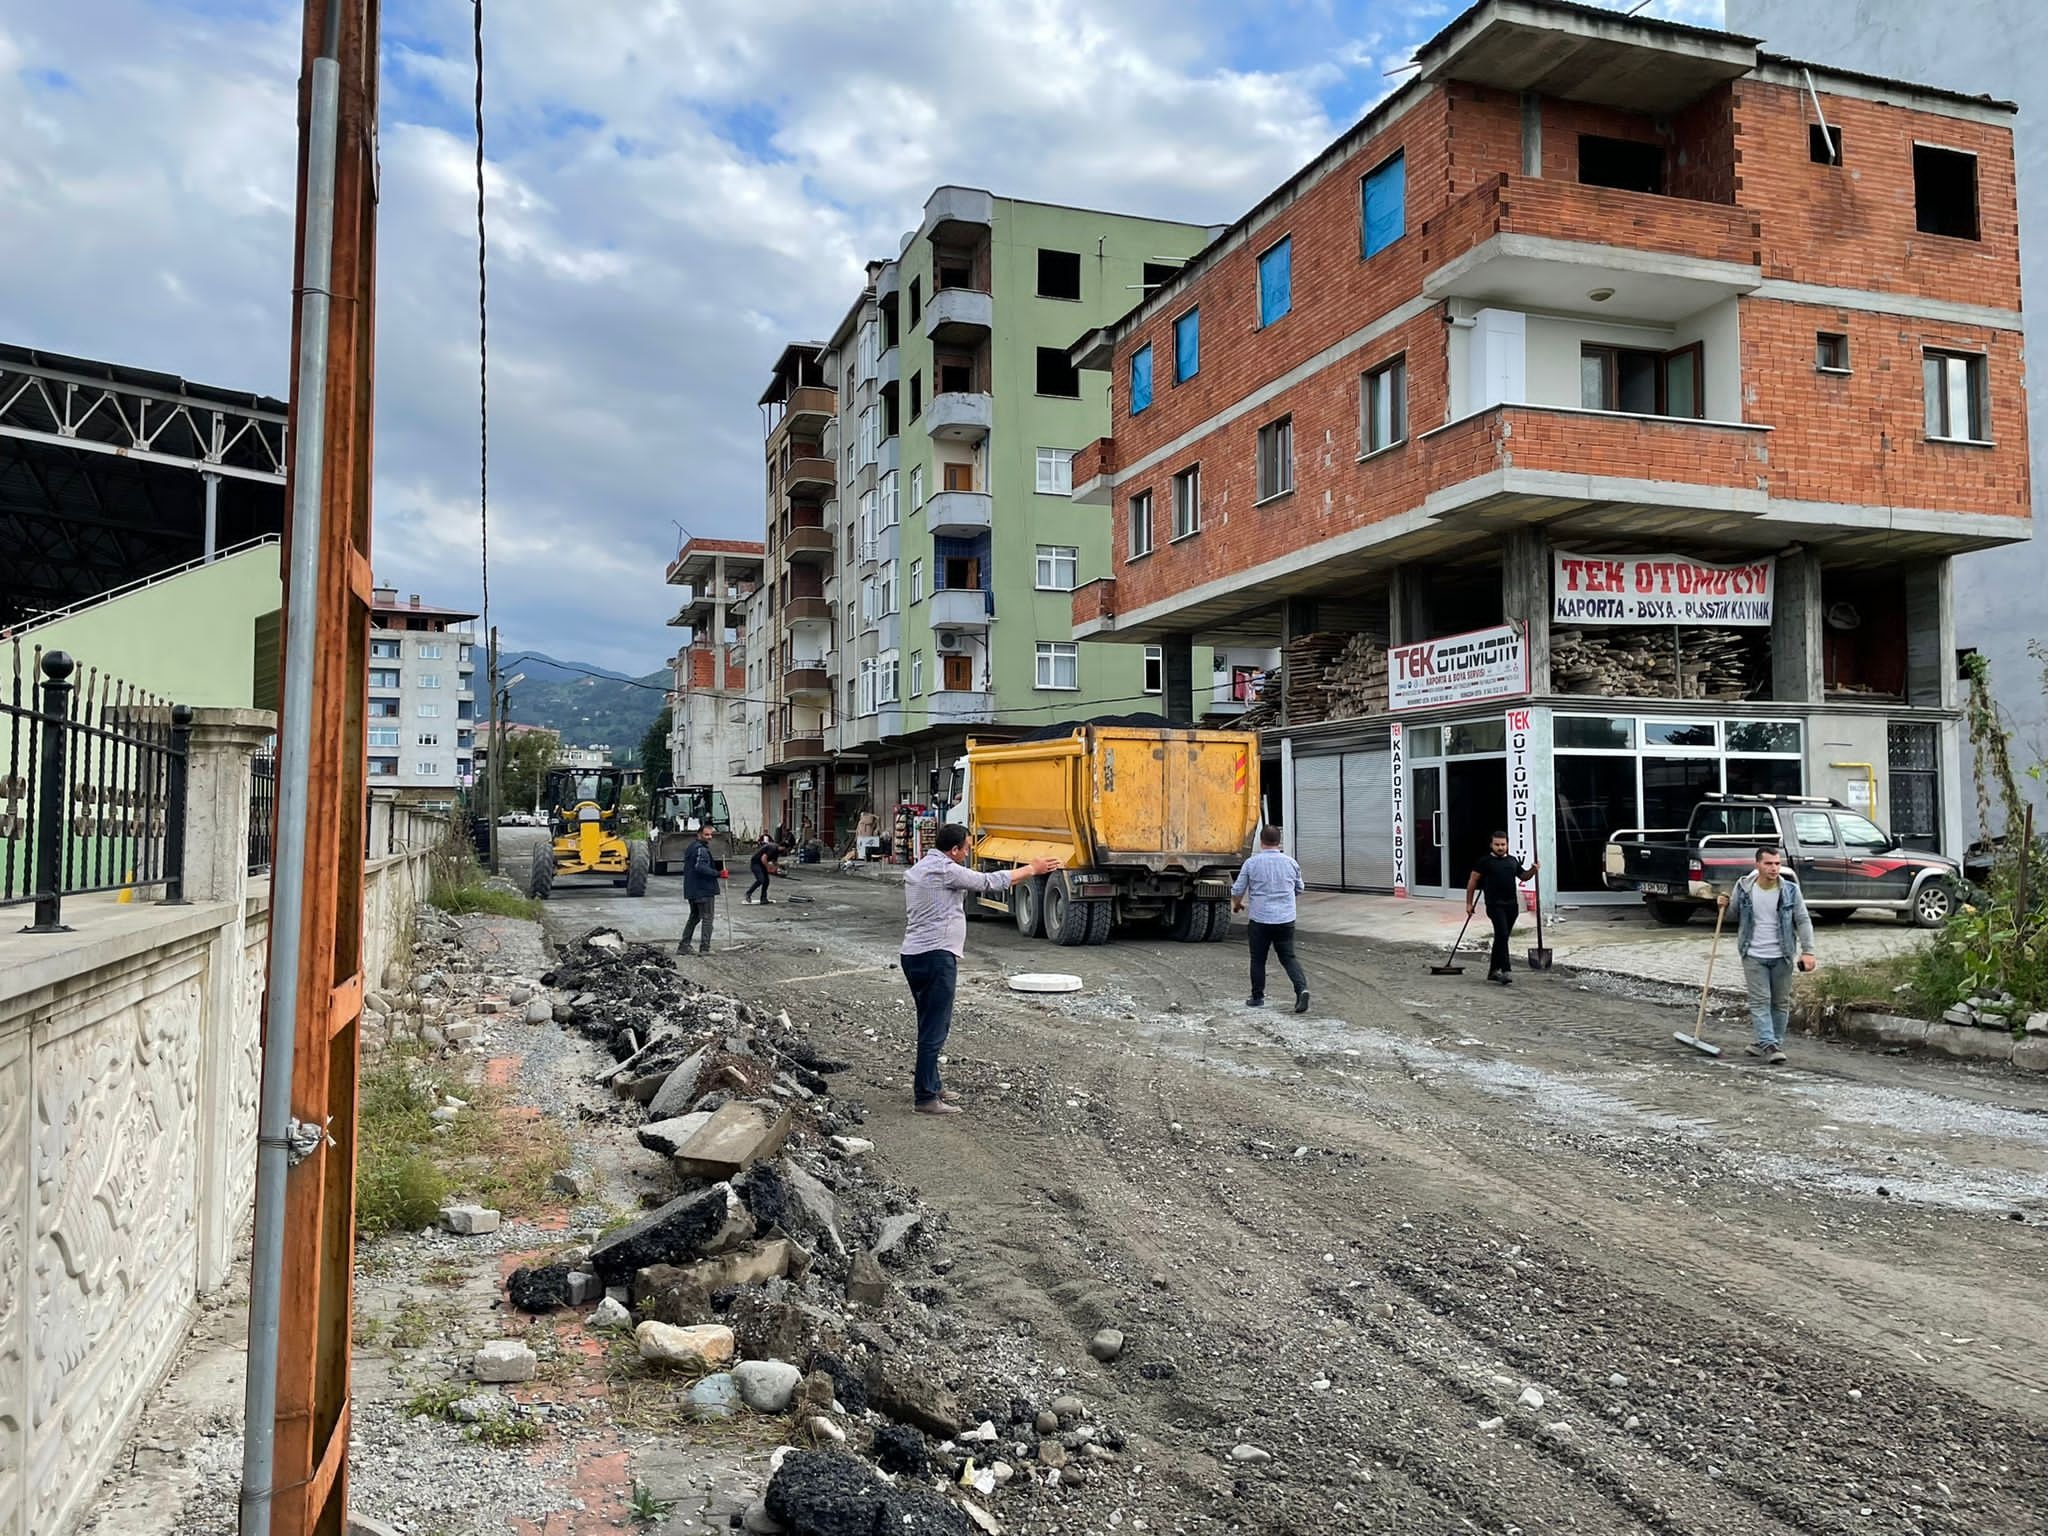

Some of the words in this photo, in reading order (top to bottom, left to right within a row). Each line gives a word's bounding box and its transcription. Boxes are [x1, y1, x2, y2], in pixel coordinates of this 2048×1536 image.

[1561, 559, 1625, 593] TEK
[1557, 598, 1624, 618] KAPORTA
[1637, 600, 1676, 618] BOYA
[1394, 645, 1435, 680] TEK
[1426, 674, 1447, 686] KAPORTA
[1453, 671, 1466, 682] BOYA
[1391, 724, 1401, 736] TEK
[1507, 711, 1530, 732] TEK
[1393, 739, 1403, 823] KAPORTA
[1395, 836, 1404, 884] BOYA
